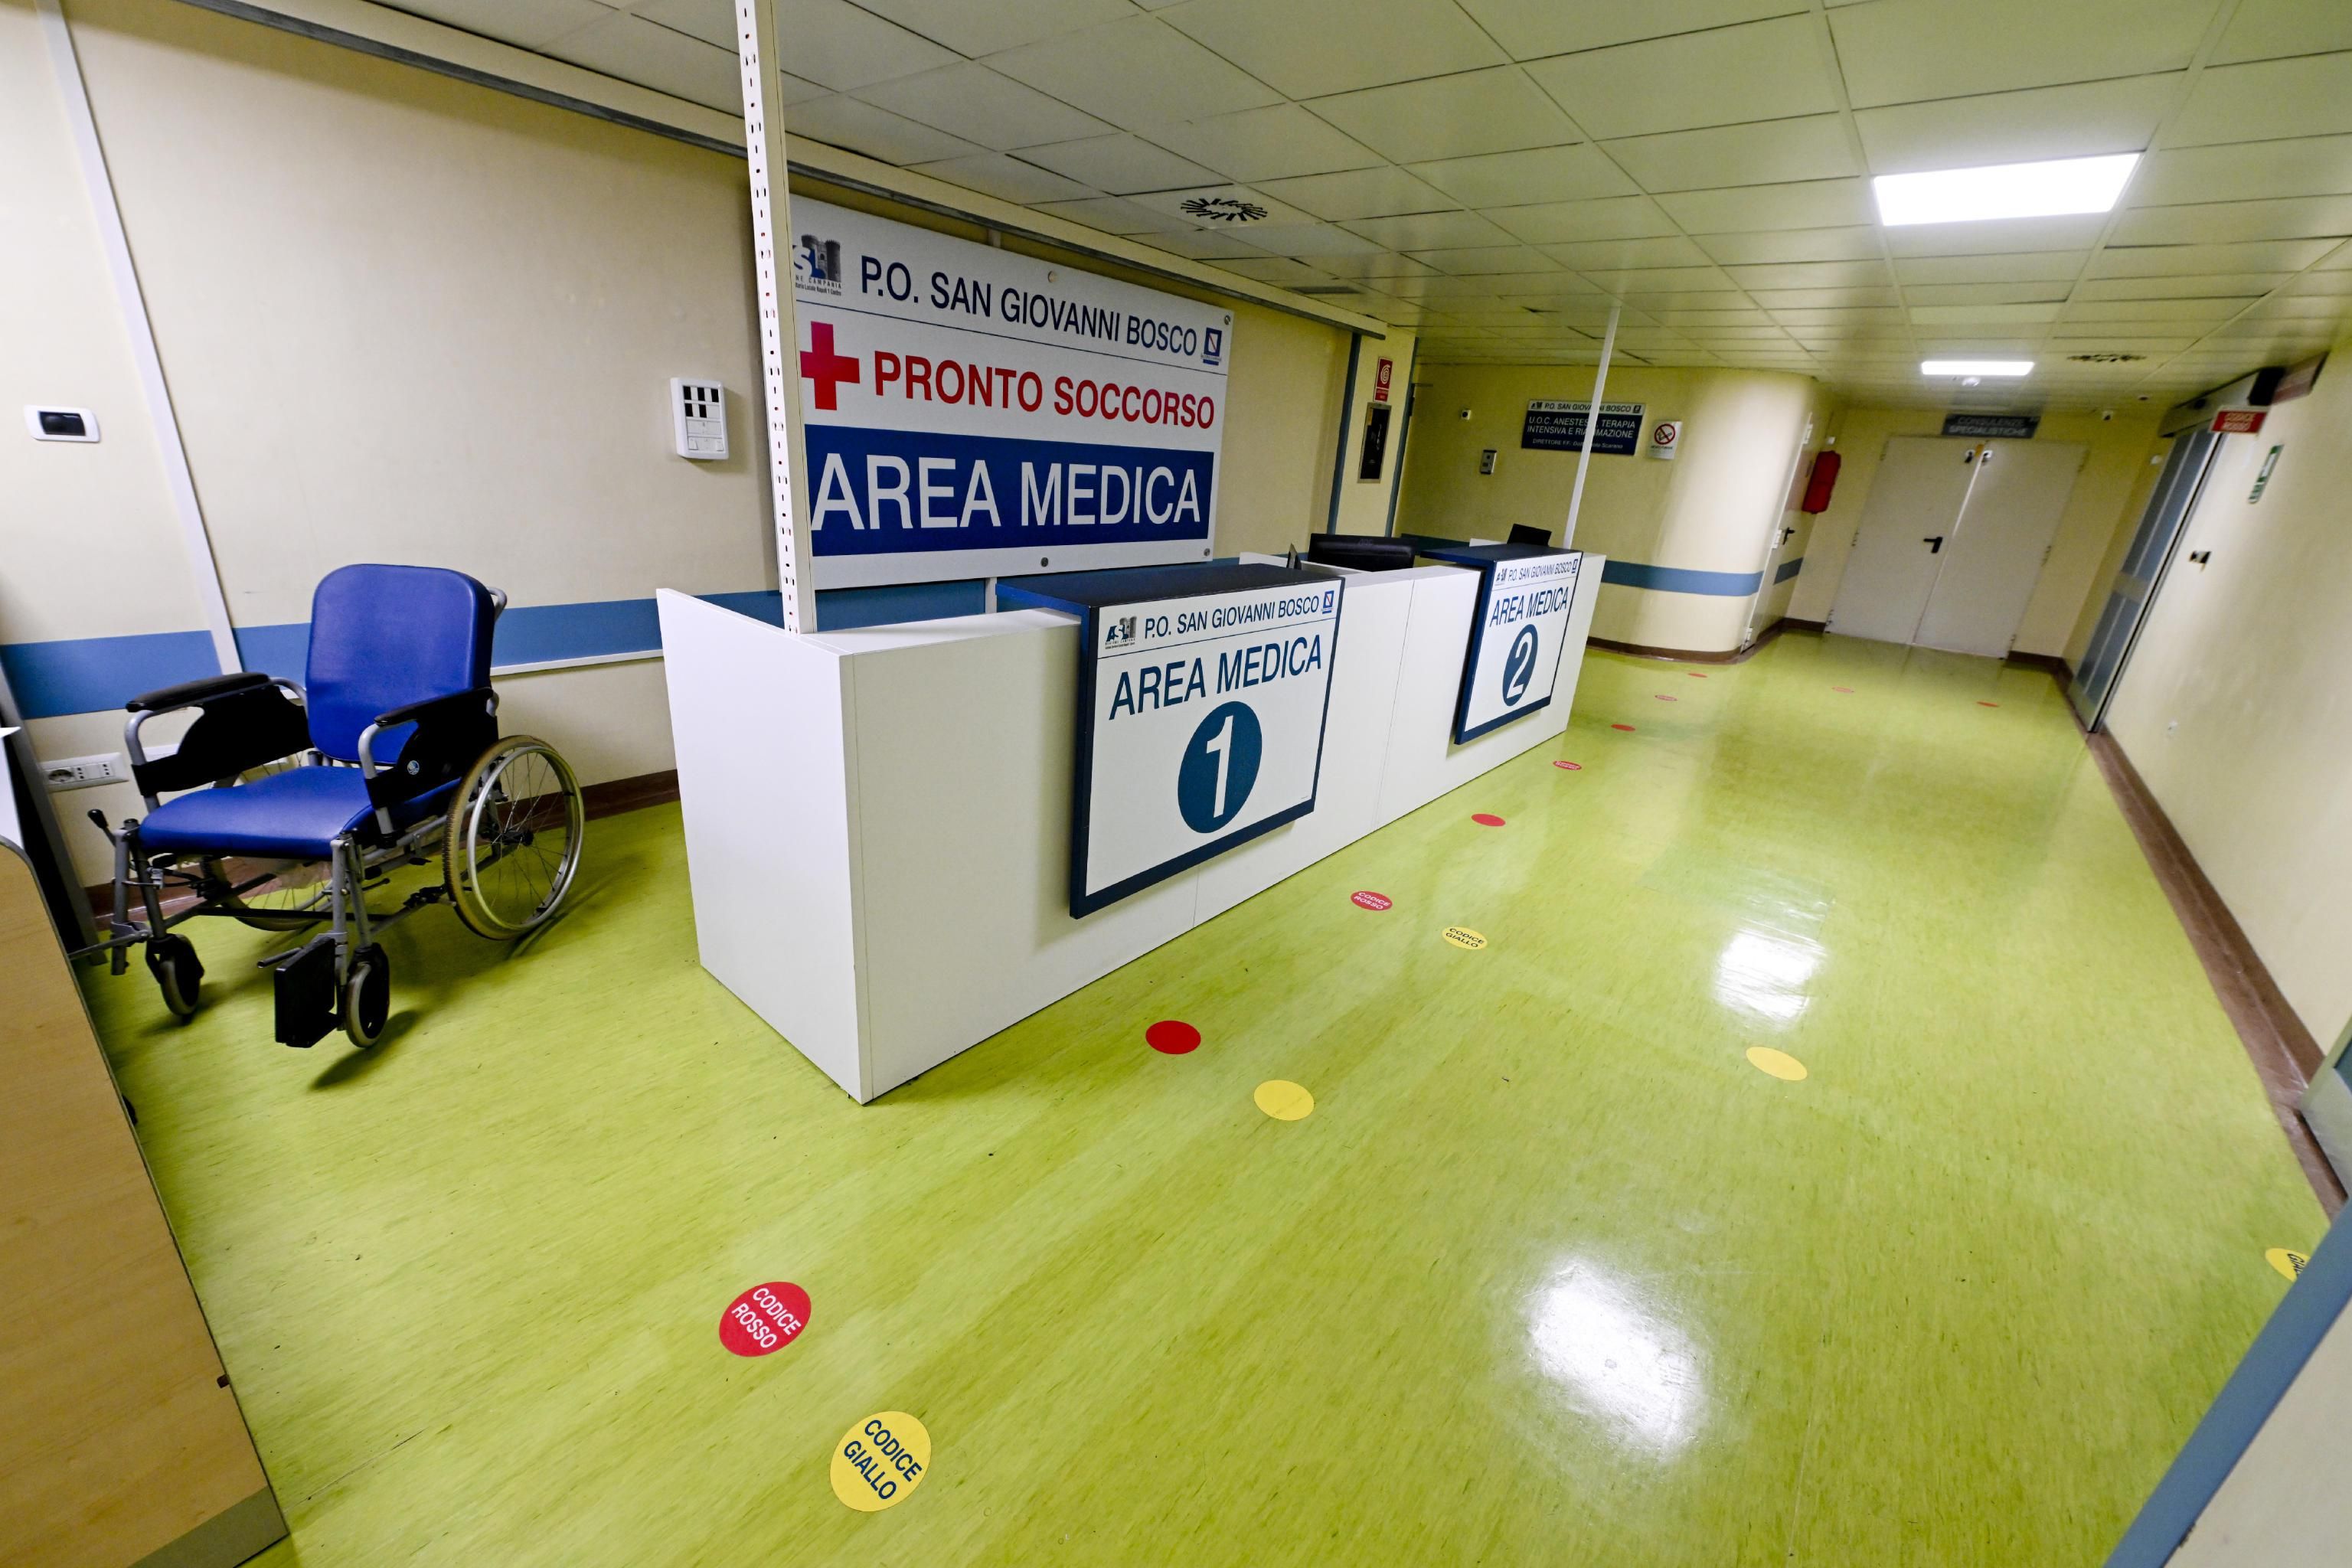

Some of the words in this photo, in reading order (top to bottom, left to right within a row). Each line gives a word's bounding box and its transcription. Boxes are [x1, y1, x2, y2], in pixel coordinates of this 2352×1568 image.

[861, 255, 919, 303] P.O.
[931, 271, 991, 318] SAN
[1001, 287, 1119, 342] GIOVANNI
[1127, 315, 1197, 356] BOSCO
[875, 350, 1043, 412] PRONTO
[1054, 376, 1214, 430] SOCCORSO
[1527, 425, 1567, 435] INTENSIVA
[1568, 426, 1573, 435] E
[1529, 416, 1552, 425] U.O.C.
[1601, 419, 1636, 429] TERAPIA
[811, 452, 1001, 531] AREA
[1021, 462, 1200, 527] MEDICA
[1518, 567, 1530, 580] SAN
[1531, 564, 1554, 578] GIOVANNI
[1554, 561, 1572, 575] BOSCO
[1145, 616, 1171, 639] P.O.
[1177, 610, 1207, 634] SAN
[1212, 602, 1276, 629] GIOVANNI
[1278, 595, 1319, 618] BOSCO
[1489, 595, 1524, 628] AREA
[1526, 586, 1569, 619] MEDICA
[1109, 657, 1207, 720] AREA
[1217, 634, 1322, 694] MEDICA
[1506, 632, 1533, 699] 2
[1206, 714, 1234, 818] 1
[1354, 895, 1383, 910] ROSSO
[1358, 892, 1390, 907] CODICE
[1446, 932, 1478, 949] GIALLO
[1449, 927, 1485, 945] CODICE
[731, 1303, 777, 1348] ROSSO
[753, 1287, 802, 1336] CODICE
[844, 1440, 897, 1500] GIALLO
[864, 1419, 923, 1482] CODICE
